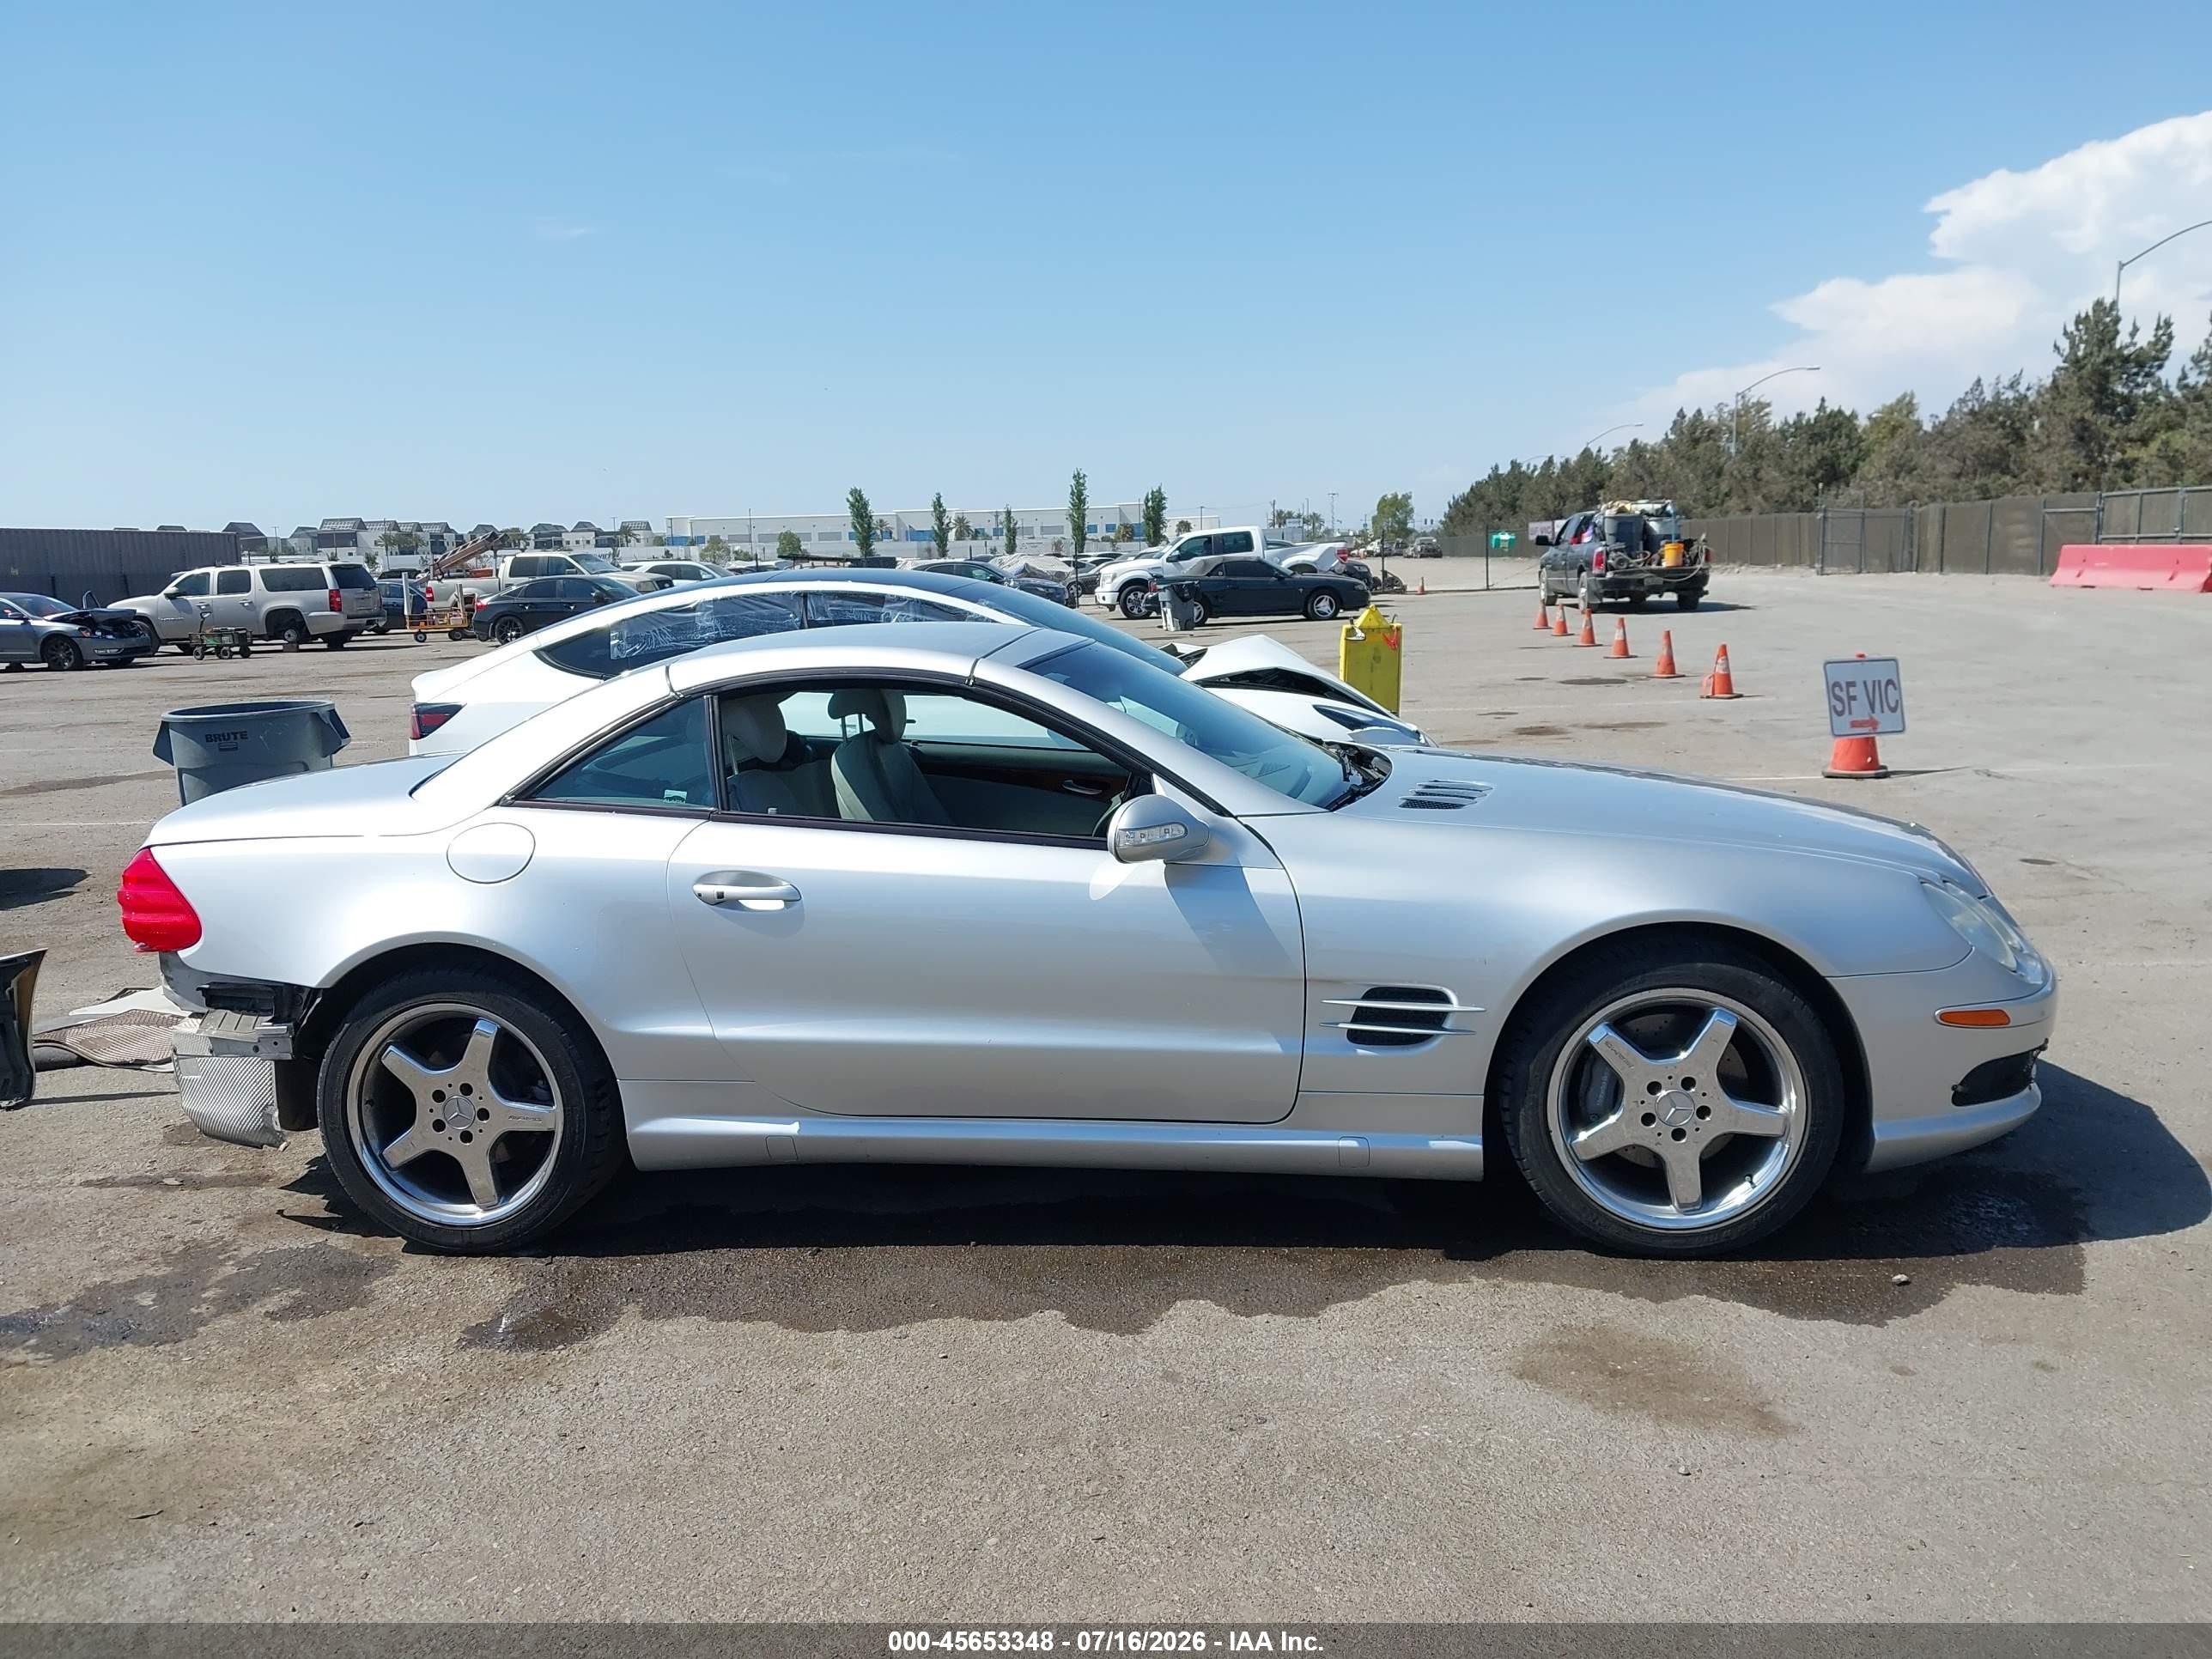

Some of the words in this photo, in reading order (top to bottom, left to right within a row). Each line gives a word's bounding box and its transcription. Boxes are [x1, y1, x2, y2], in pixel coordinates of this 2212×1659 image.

[1831, 680, 1858, 717] SF
[1863, 678, 1899, 714] VIC
[204, 730, 249, 743] BRUTE
